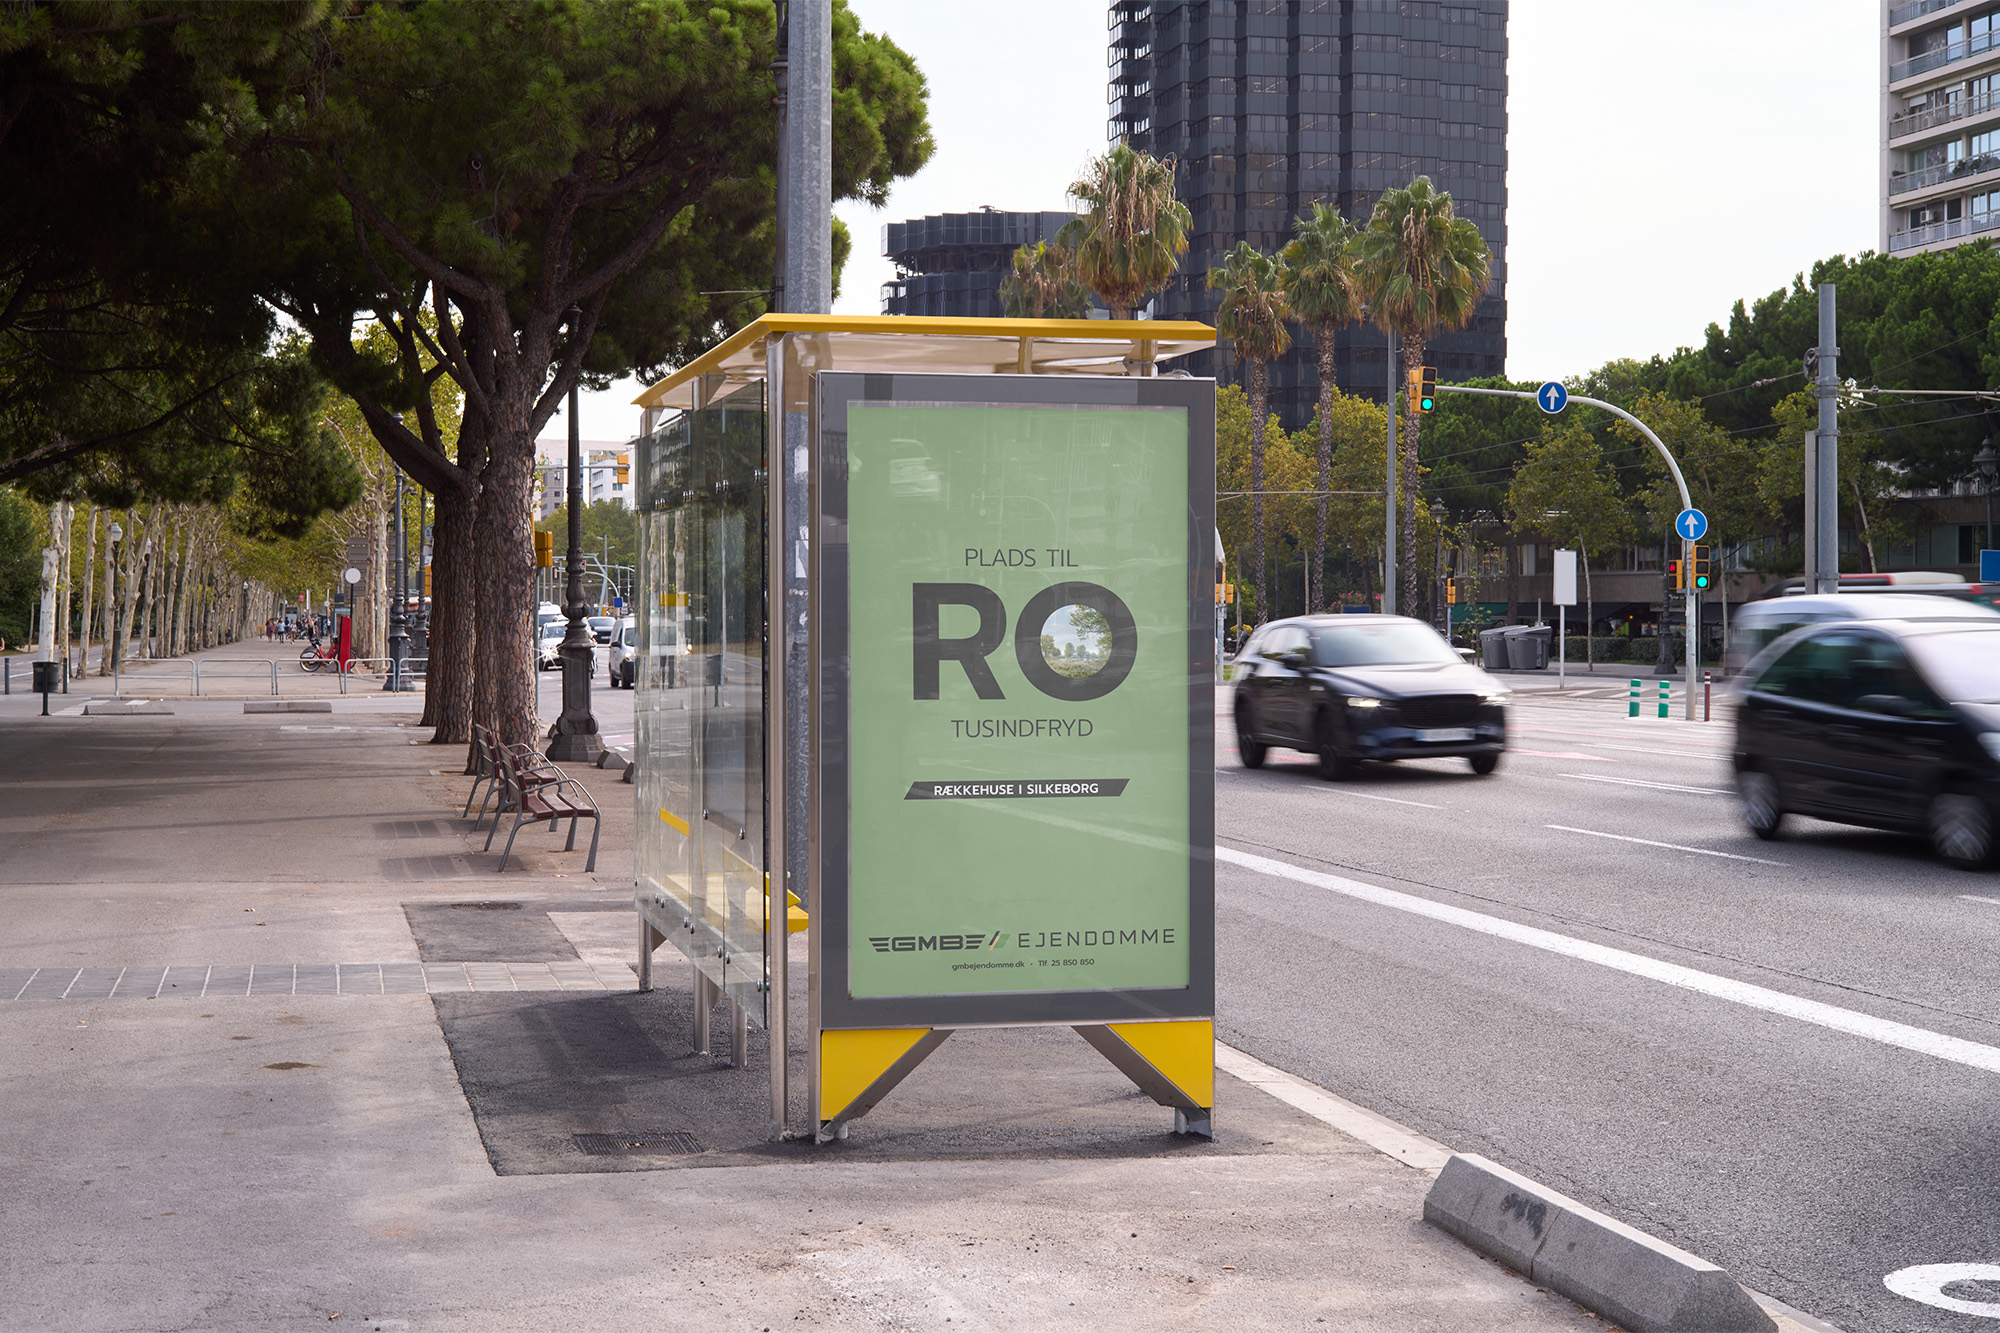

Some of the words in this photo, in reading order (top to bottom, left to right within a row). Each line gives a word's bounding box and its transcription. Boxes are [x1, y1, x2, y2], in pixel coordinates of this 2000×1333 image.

[965, 548, 1036, 567] PLADS
[1046, 549, 1079, 567] TIL
[912, 581, 1138, 702] RO
[951, 719, 1094, 738] TUSINDFRYD
[934, 784, 1014, 796] RÆKKEHUSE
[1018, 784, 1023, 795] I
[1026, 783, 1099, 795] SILKEBORG
[1018, 928, 1175, 948] EJENDOMME
[952, 960, 1025, 972] gmbejendomme.dk
[1051, 959, 1061, 967] 25
[1063, 959, 1078, 967] 850
[1079, 958, 1095, 966] 850
